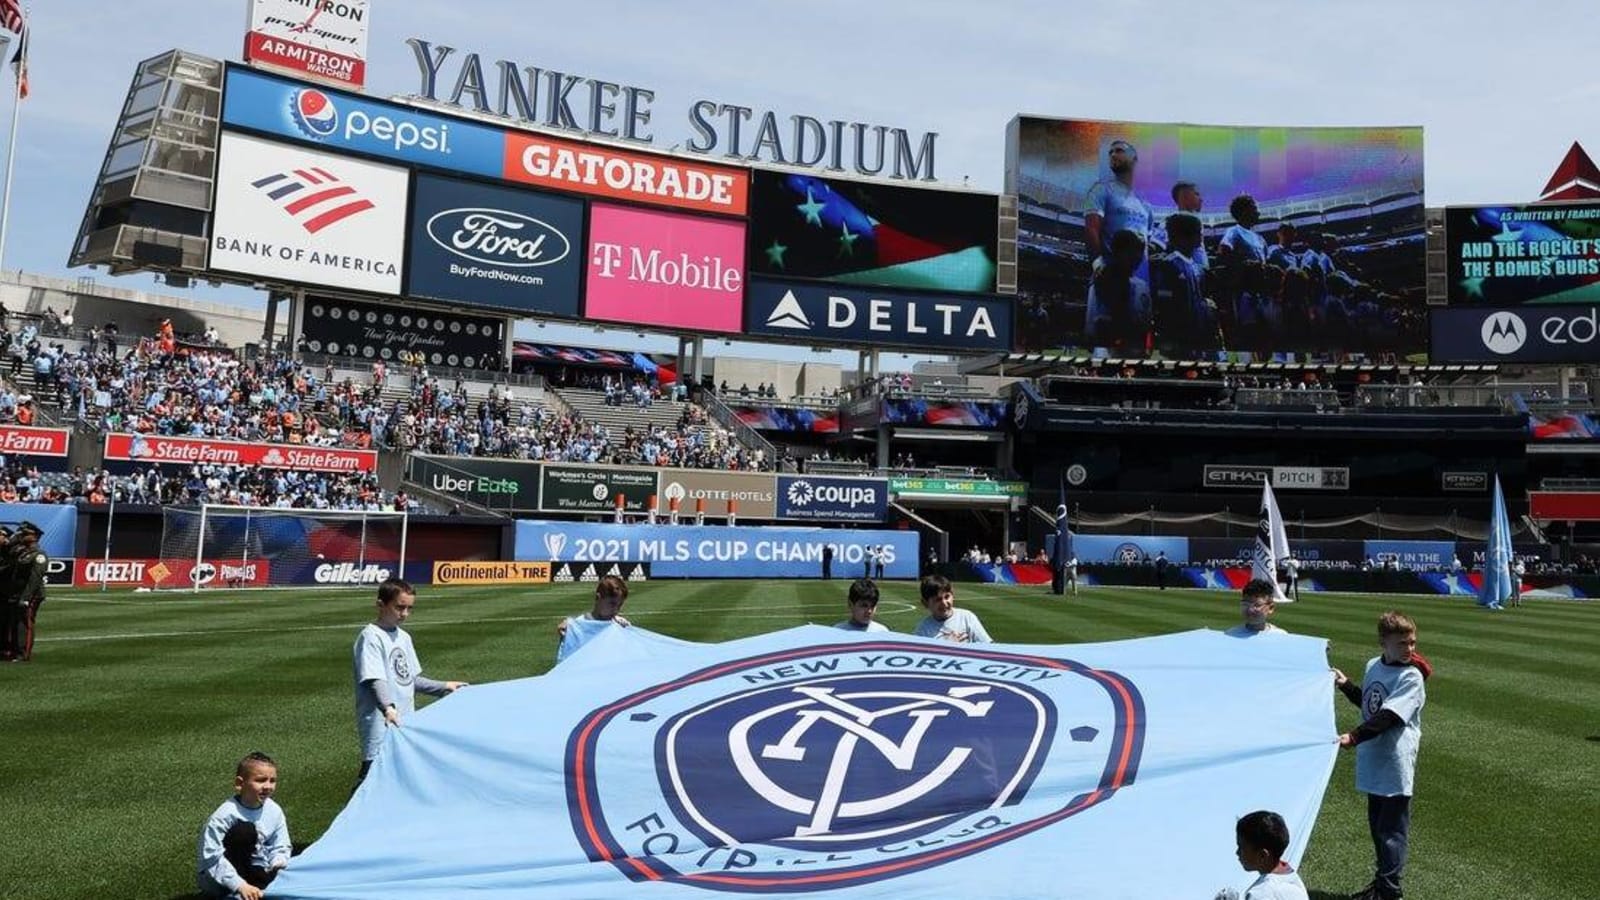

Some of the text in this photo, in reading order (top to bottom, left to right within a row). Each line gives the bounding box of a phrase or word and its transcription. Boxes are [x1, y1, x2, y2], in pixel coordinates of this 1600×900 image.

[261, 40, 354, 73] ARMITRON
[307, 63, 351, 80] WATCHES
[405, 38, 939, 182] YANKEE STADIUM
[345, 110, 449, 153] pepsi
[521, 144, 734, 205] GATORADE
[1500, 212, 1512, 221] AS
[1514, 211, 1552, 220] WRITTEN
[1554, 210, 1565, 219] BY
[452, 213, 546, 260] Ford
[216, 236, 398, 276] BANK OF AMERICA
[1462, 242, 1493, 258] AND
[1496, 241, 1525, 257] THE
[450, 264, 544, 286] BuyFordNow.com
[1462, 258, 1600, 277] THE BOMBS BURS
[827, 295, 996, 338] DELTA
[1541, 307, 1600, 344] ed
[363, 327, 445, 347] New York Yankees
[433, 473, 518, 494] Uber Eats
[1208, 471, 1315, 483] ETIHAD PITCH
[689, 489, 772, 502] LOTTE HOTELS
[815, 486, 875, 508] coupa
[574, 539, 629, 561] 2021
[639, 540, 690, 561] MLS
[698, 541, 747, 561] CUP
[1404, 553, 1415, 561] IN
[1419, 553, 1440, 562] THE
[85, 562, 145, 581] CHEEZ-IT
[314, 562, 390, 583] Gillette
[437, 563, 548, 583] Continental TIRE
[742, 655, 1061, 683] NEW YORK CITY
